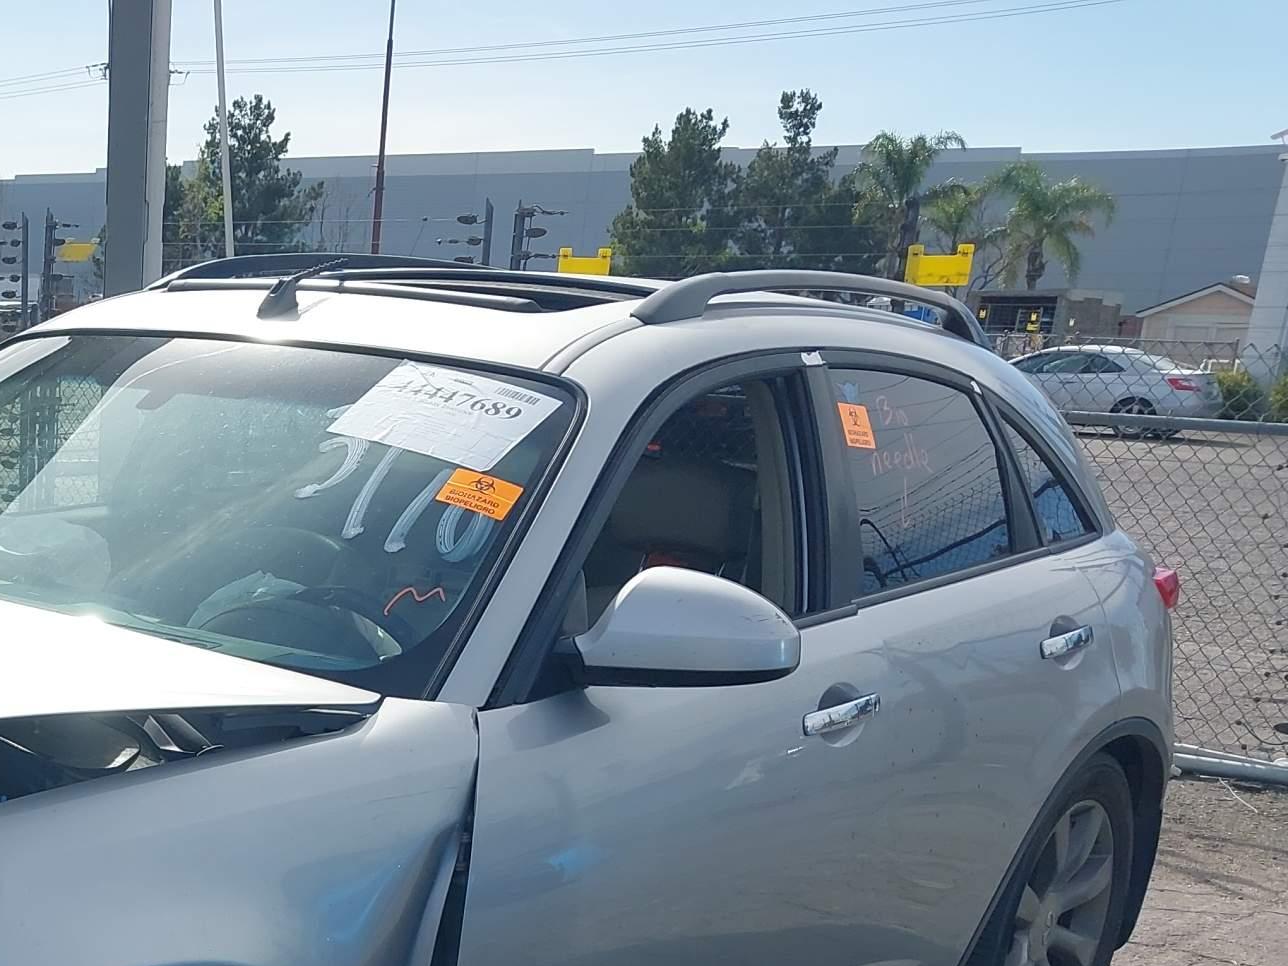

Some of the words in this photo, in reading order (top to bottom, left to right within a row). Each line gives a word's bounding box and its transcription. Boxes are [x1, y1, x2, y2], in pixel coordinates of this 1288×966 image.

[394, 380, 523, 420] 44447689
[445, 495, 496, 515] BIOPELIGRO
[449, 489, 500, 508] BIOHAZARD
